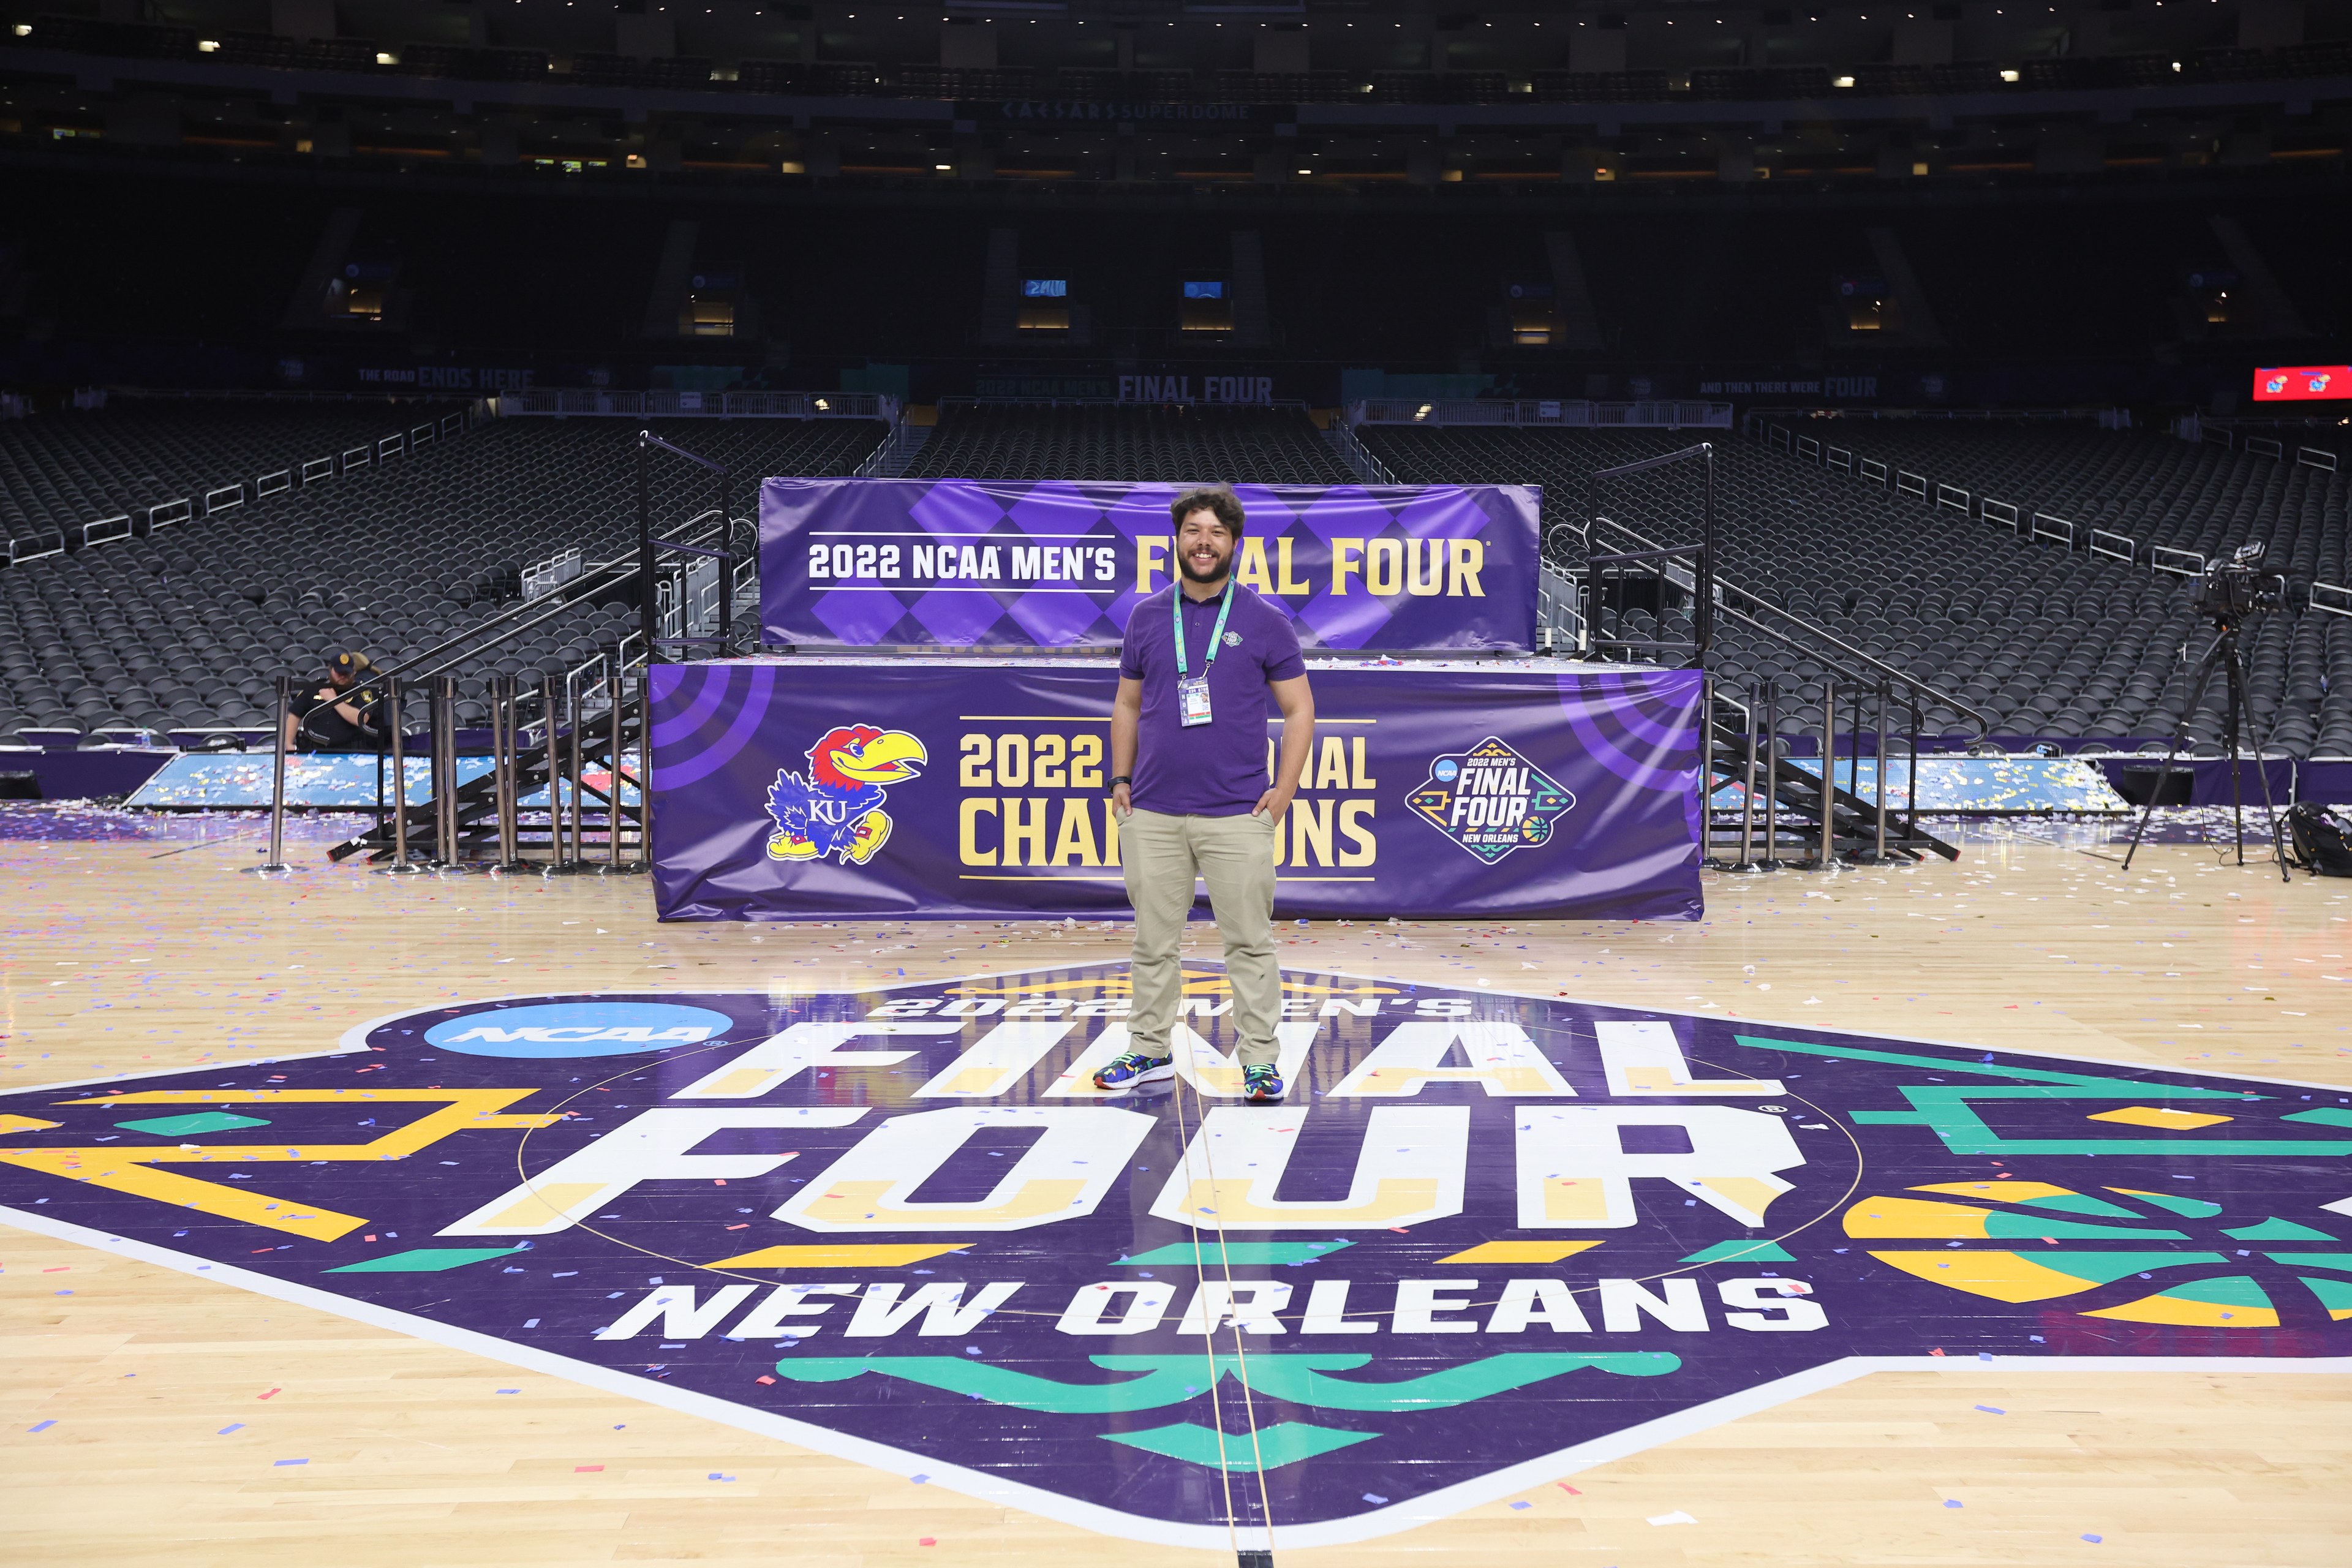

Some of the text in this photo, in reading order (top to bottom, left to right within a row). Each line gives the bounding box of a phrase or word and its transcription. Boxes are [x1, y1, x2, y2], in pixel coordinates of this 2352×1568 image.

[1002, 103, 1250, 119] CAESARS SUPERDOME
[358, 367, 534, 390] THE ROAD ENDS HERE
[1021, 380, 1060, 396] NCAA
[1063, 380, 1110, 396] MEN'S
[1118, 375, 1194, 404] FINAL
[1204, 375, 1273, 403] FOUR
[1700, 376, 1877, 397] AND THEN THERE WERE FOUR
[809, 535, 1487, 597] 2022 NCAA MEN'S FAL FOUR
[960, 734, 1102, 788] 2022
[1467, 758, 1516, 766] 2022 MEN'S
[1456, 767, 1531, 795] FINAL
[807, 799, 847, 825] KU
[1450, 797, 1529, 826] FOUR
[960, 797, 1376, 867] CHANS
[1462, 834, 1518, 843] NEW ORLEANS
[865, 998, 1132, 1017] 2022
[442, 1027, 713, 1042] NCAA
[668, 1021, 1787, 1098] FINAL
[434, 1105, 1807, 1236] FOUR
[593, 1278, 1830, 1341] NEW ORLEANS
